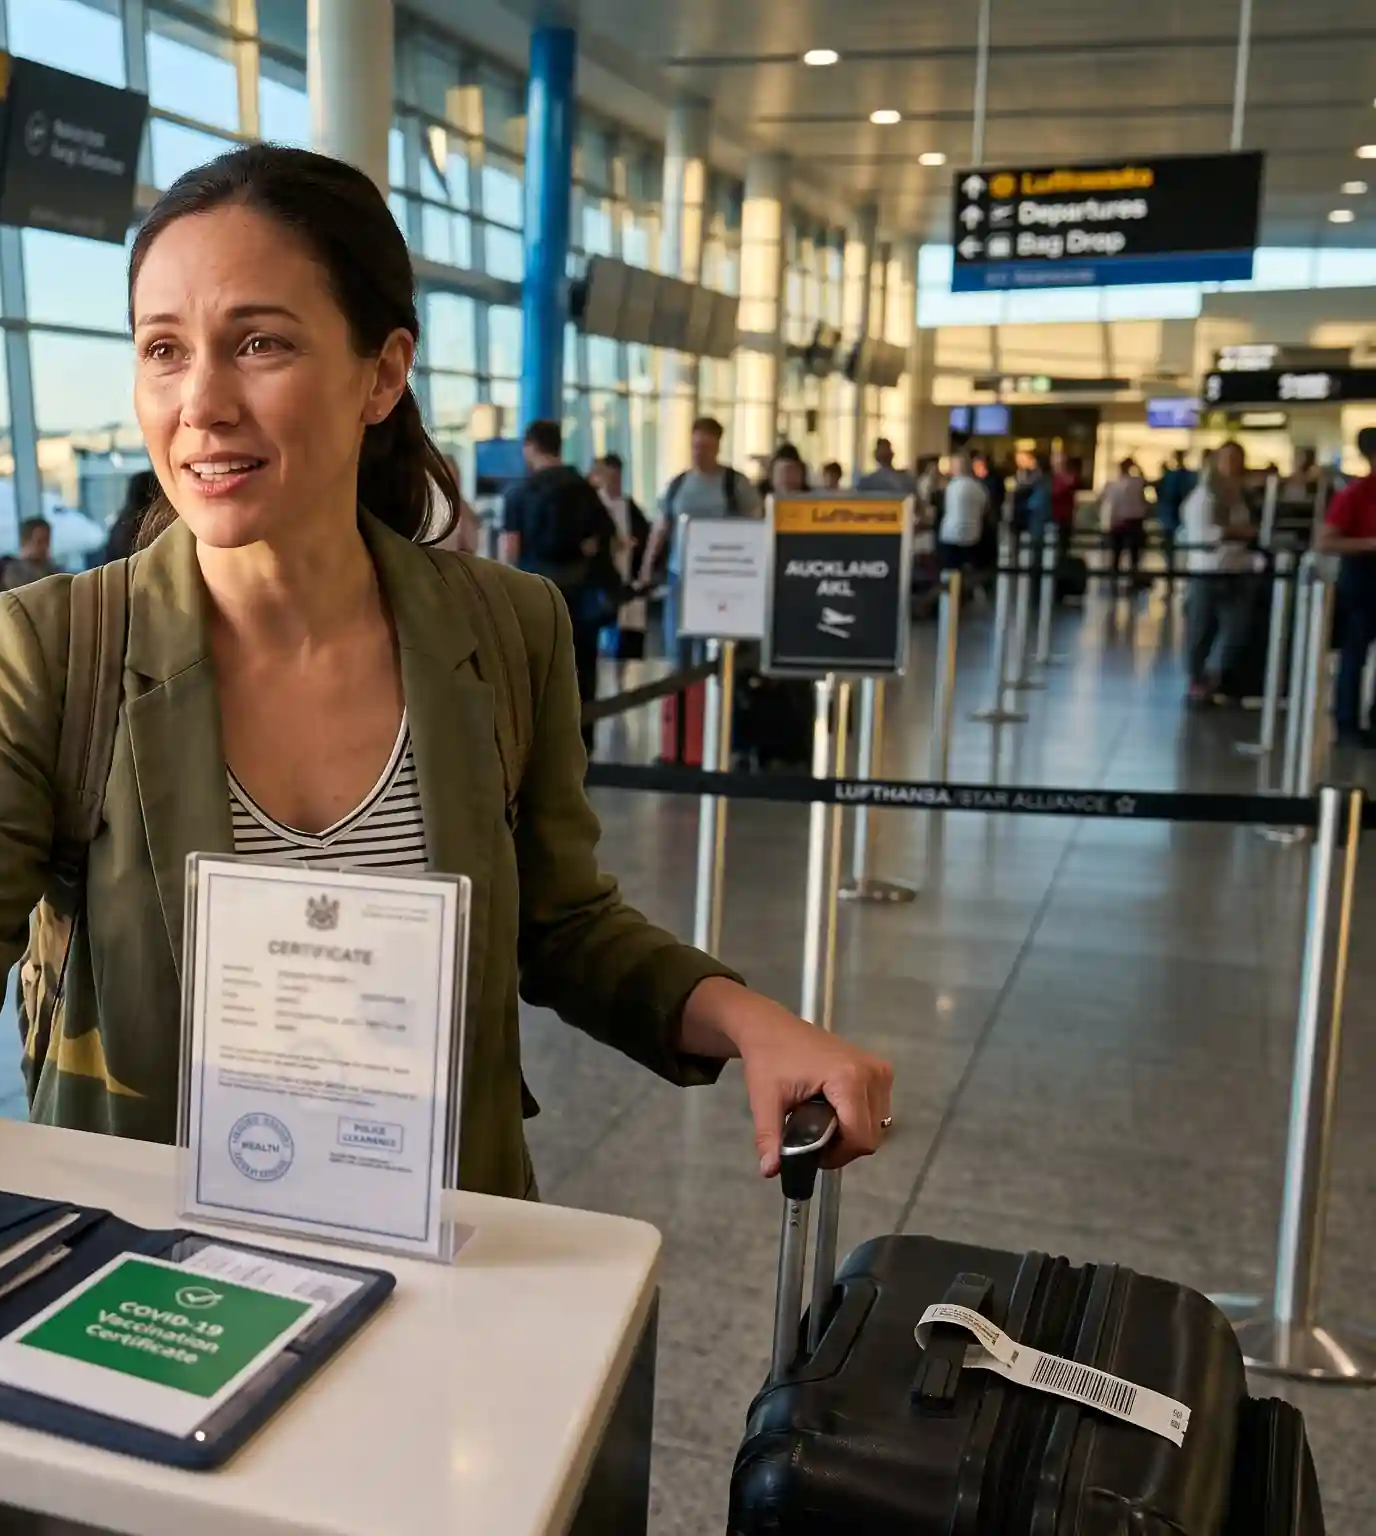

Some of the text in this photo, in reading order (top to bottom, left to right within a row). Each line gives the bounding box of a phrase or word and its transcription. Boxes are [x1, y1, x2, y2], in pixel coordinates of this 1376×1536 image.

[1018, 198, 1148, 228] Departures
[1017, 229, 1127, 259] Bag Drop
[785, 560, 890, 579] AUCKLAND
[816, 579, 856, 597] AKL
[267, 939, 374, 966] CERTIFICATE
[241, 1141, 280, 1153] HEALTH
[98, 1309, 220, 1355] Vaccination
[118, 1301, 225, 1338] COVID-19
[85, 1324, 199, 1365] Certificate
